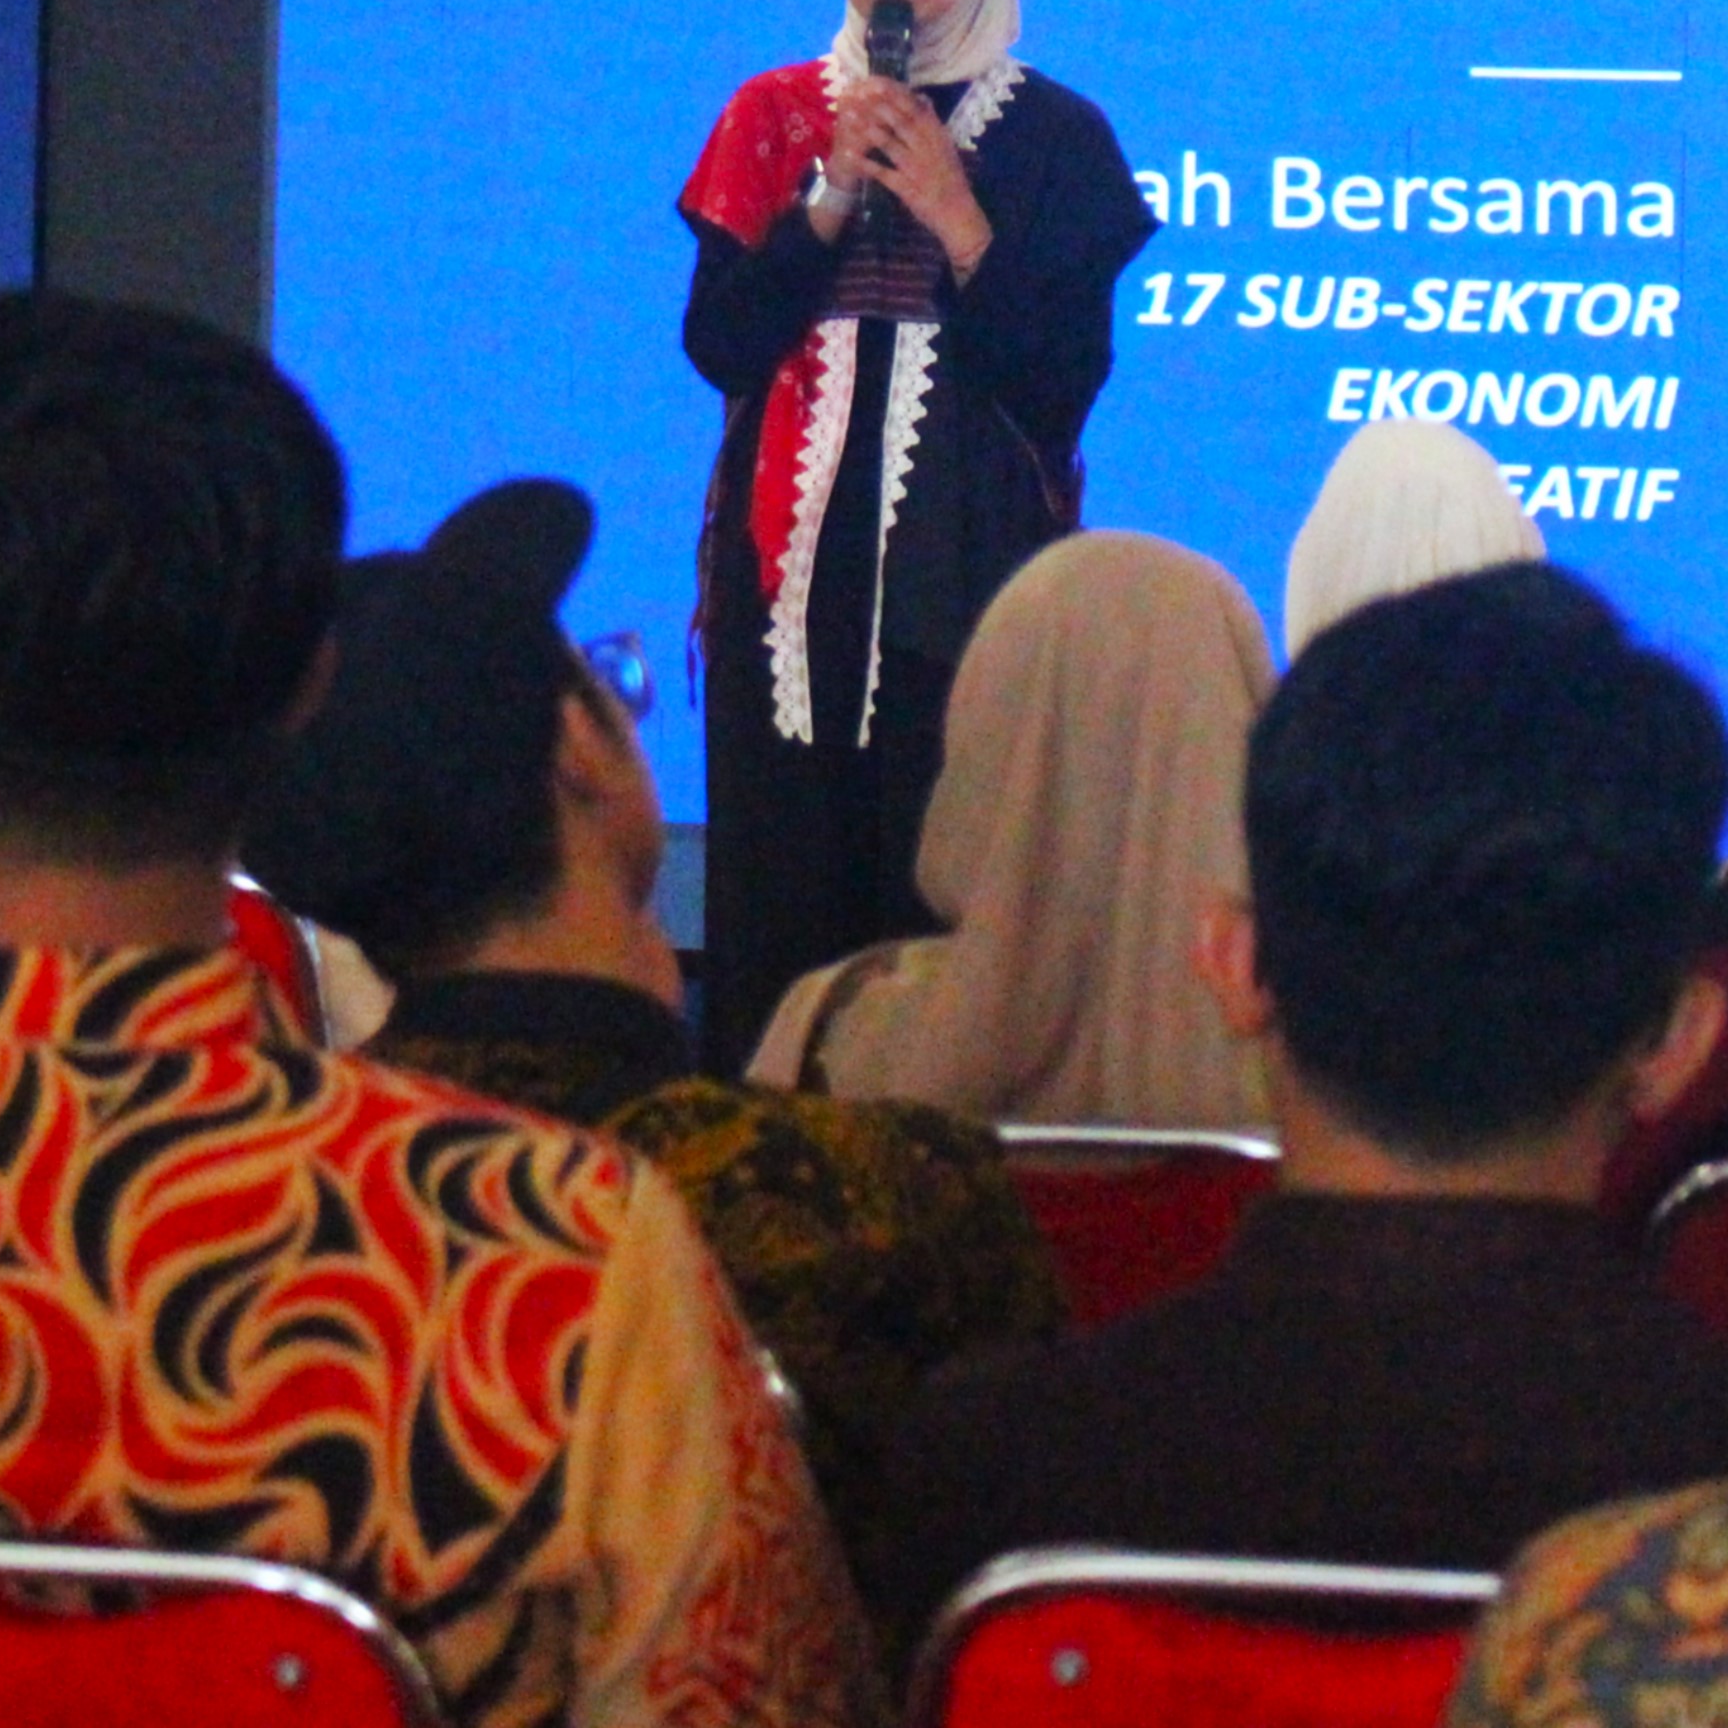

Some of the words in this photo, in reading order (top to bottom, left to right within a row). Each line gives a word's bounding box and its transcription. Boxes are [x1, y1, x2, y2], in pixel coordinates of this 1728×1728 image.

[1272, 156, 1675, 238] Bersama
[1137, 272, 1226, 326] 17
[1237, 273, 1681, 338] SUB-SEKTOR
[1327, 368, 1680, 430] EKONOMI
